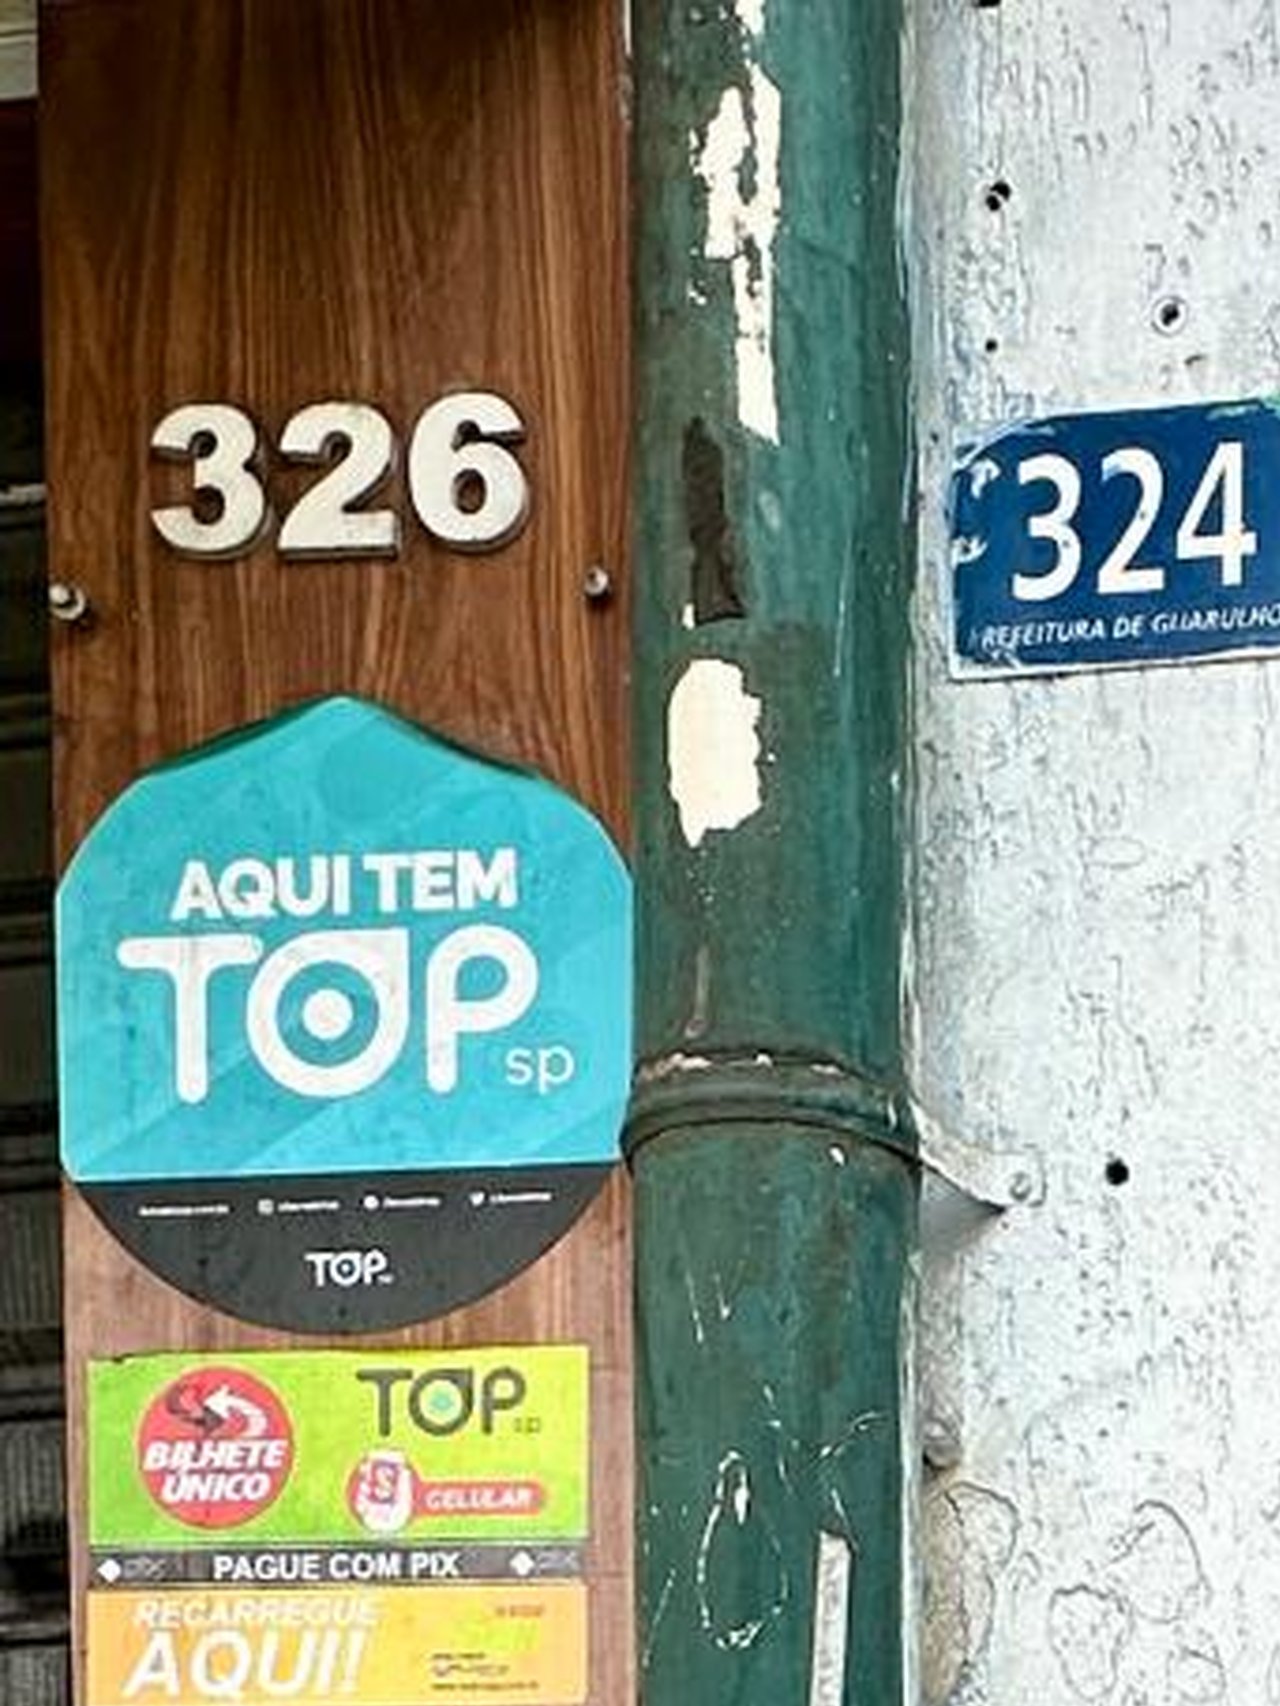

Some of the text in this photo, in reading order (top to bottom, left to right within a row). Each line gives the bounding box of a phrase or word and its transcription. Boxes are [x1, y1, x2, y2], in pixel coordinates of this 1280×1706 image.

[150, 390, 530, 558] 326
[1012, 441, 1258, 602] 324
[1112, 613, 1147, 638] DE
[170, 847, 518, 921] AQUI TEM
[116, 923, 575, 1104] TOP sp
[304, 1249, 388, 1288] TOP
[356, 1366, 527, 1437] TOP
[143, 1438, 289, 1471] BILHETE
[424, 1487, 533, 1510] CELULAR
[213, 1551, 461, 1580] PAGUE COM PIX
[133, 1598, 380, 1630] RECARREGUE
